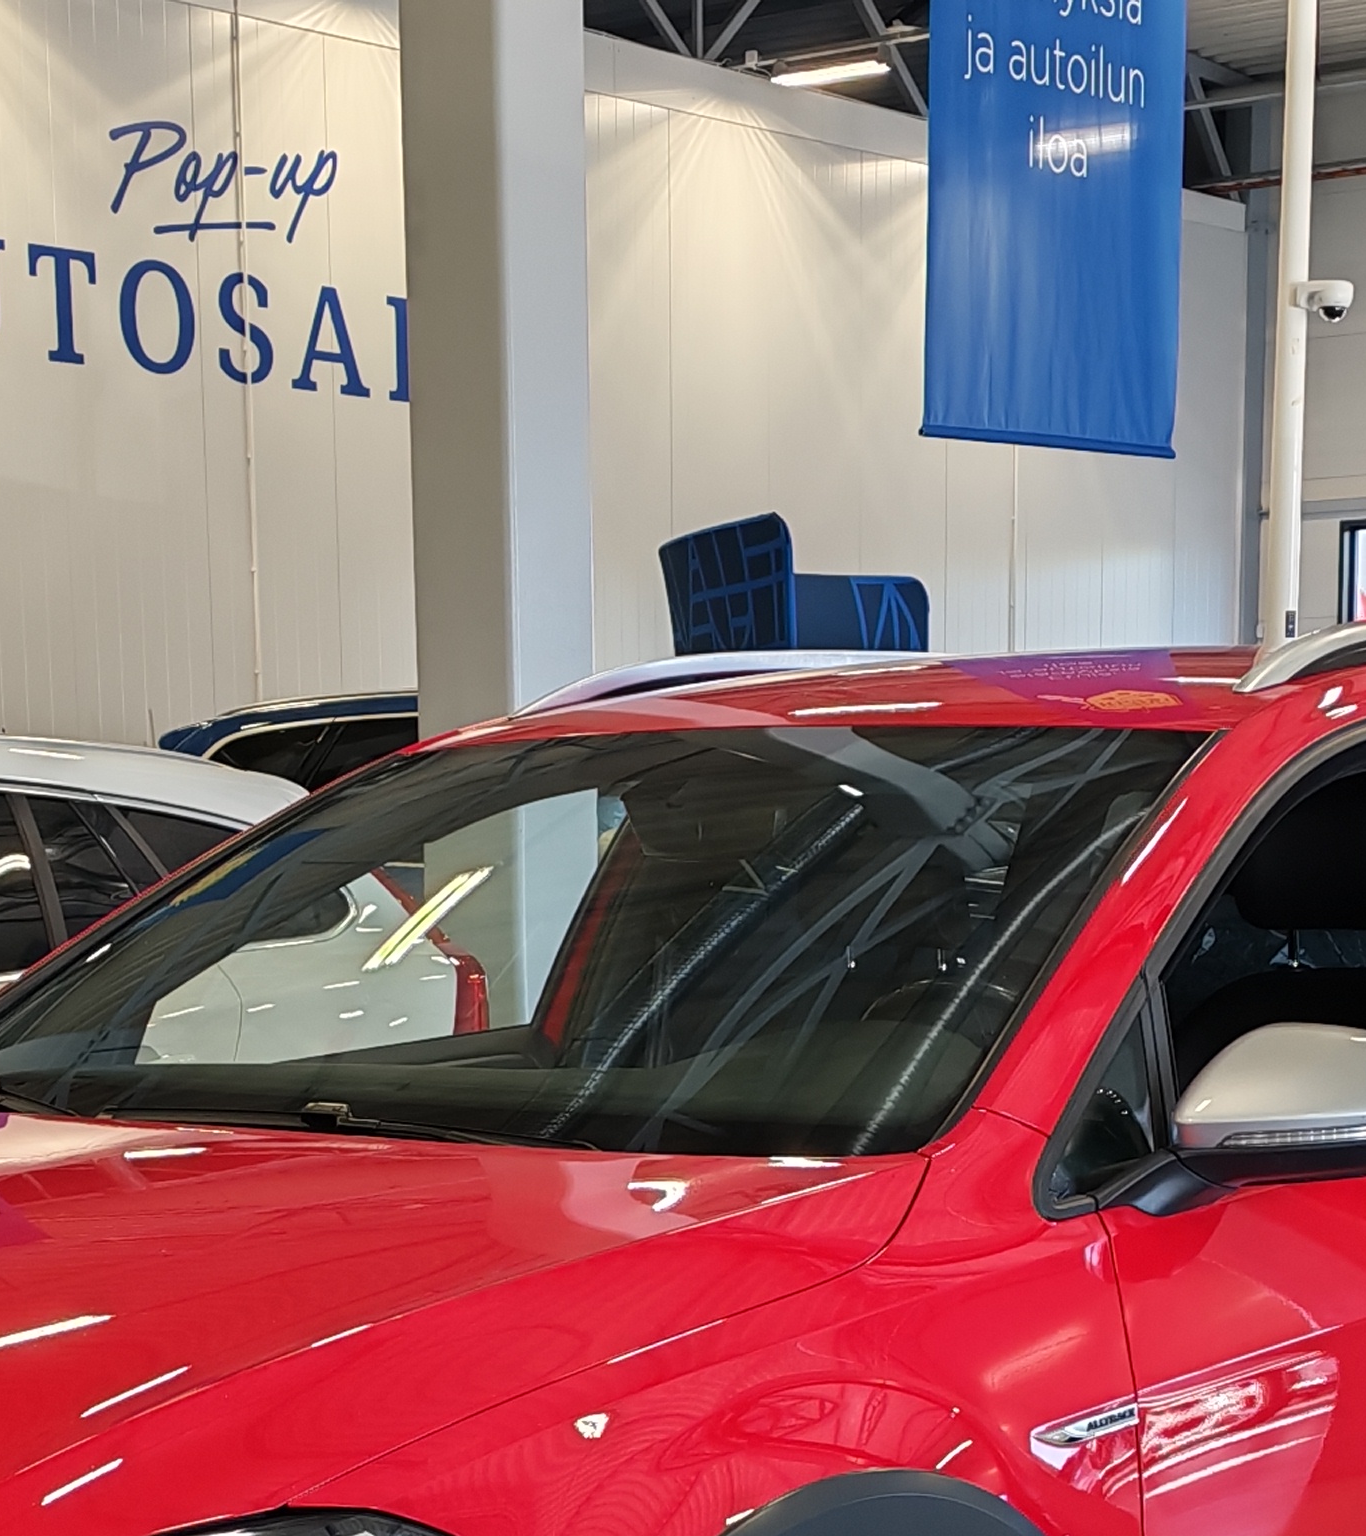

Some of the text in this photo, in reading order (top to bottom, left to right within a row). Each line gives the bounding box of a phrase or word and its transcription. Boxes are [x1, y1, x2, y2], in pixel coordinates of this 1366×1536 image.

[964, 14, 1145, 108] ja autoilun
[108, 120, 338, 243] Pop-up
[1029, 115, 1088, 178] iloa
